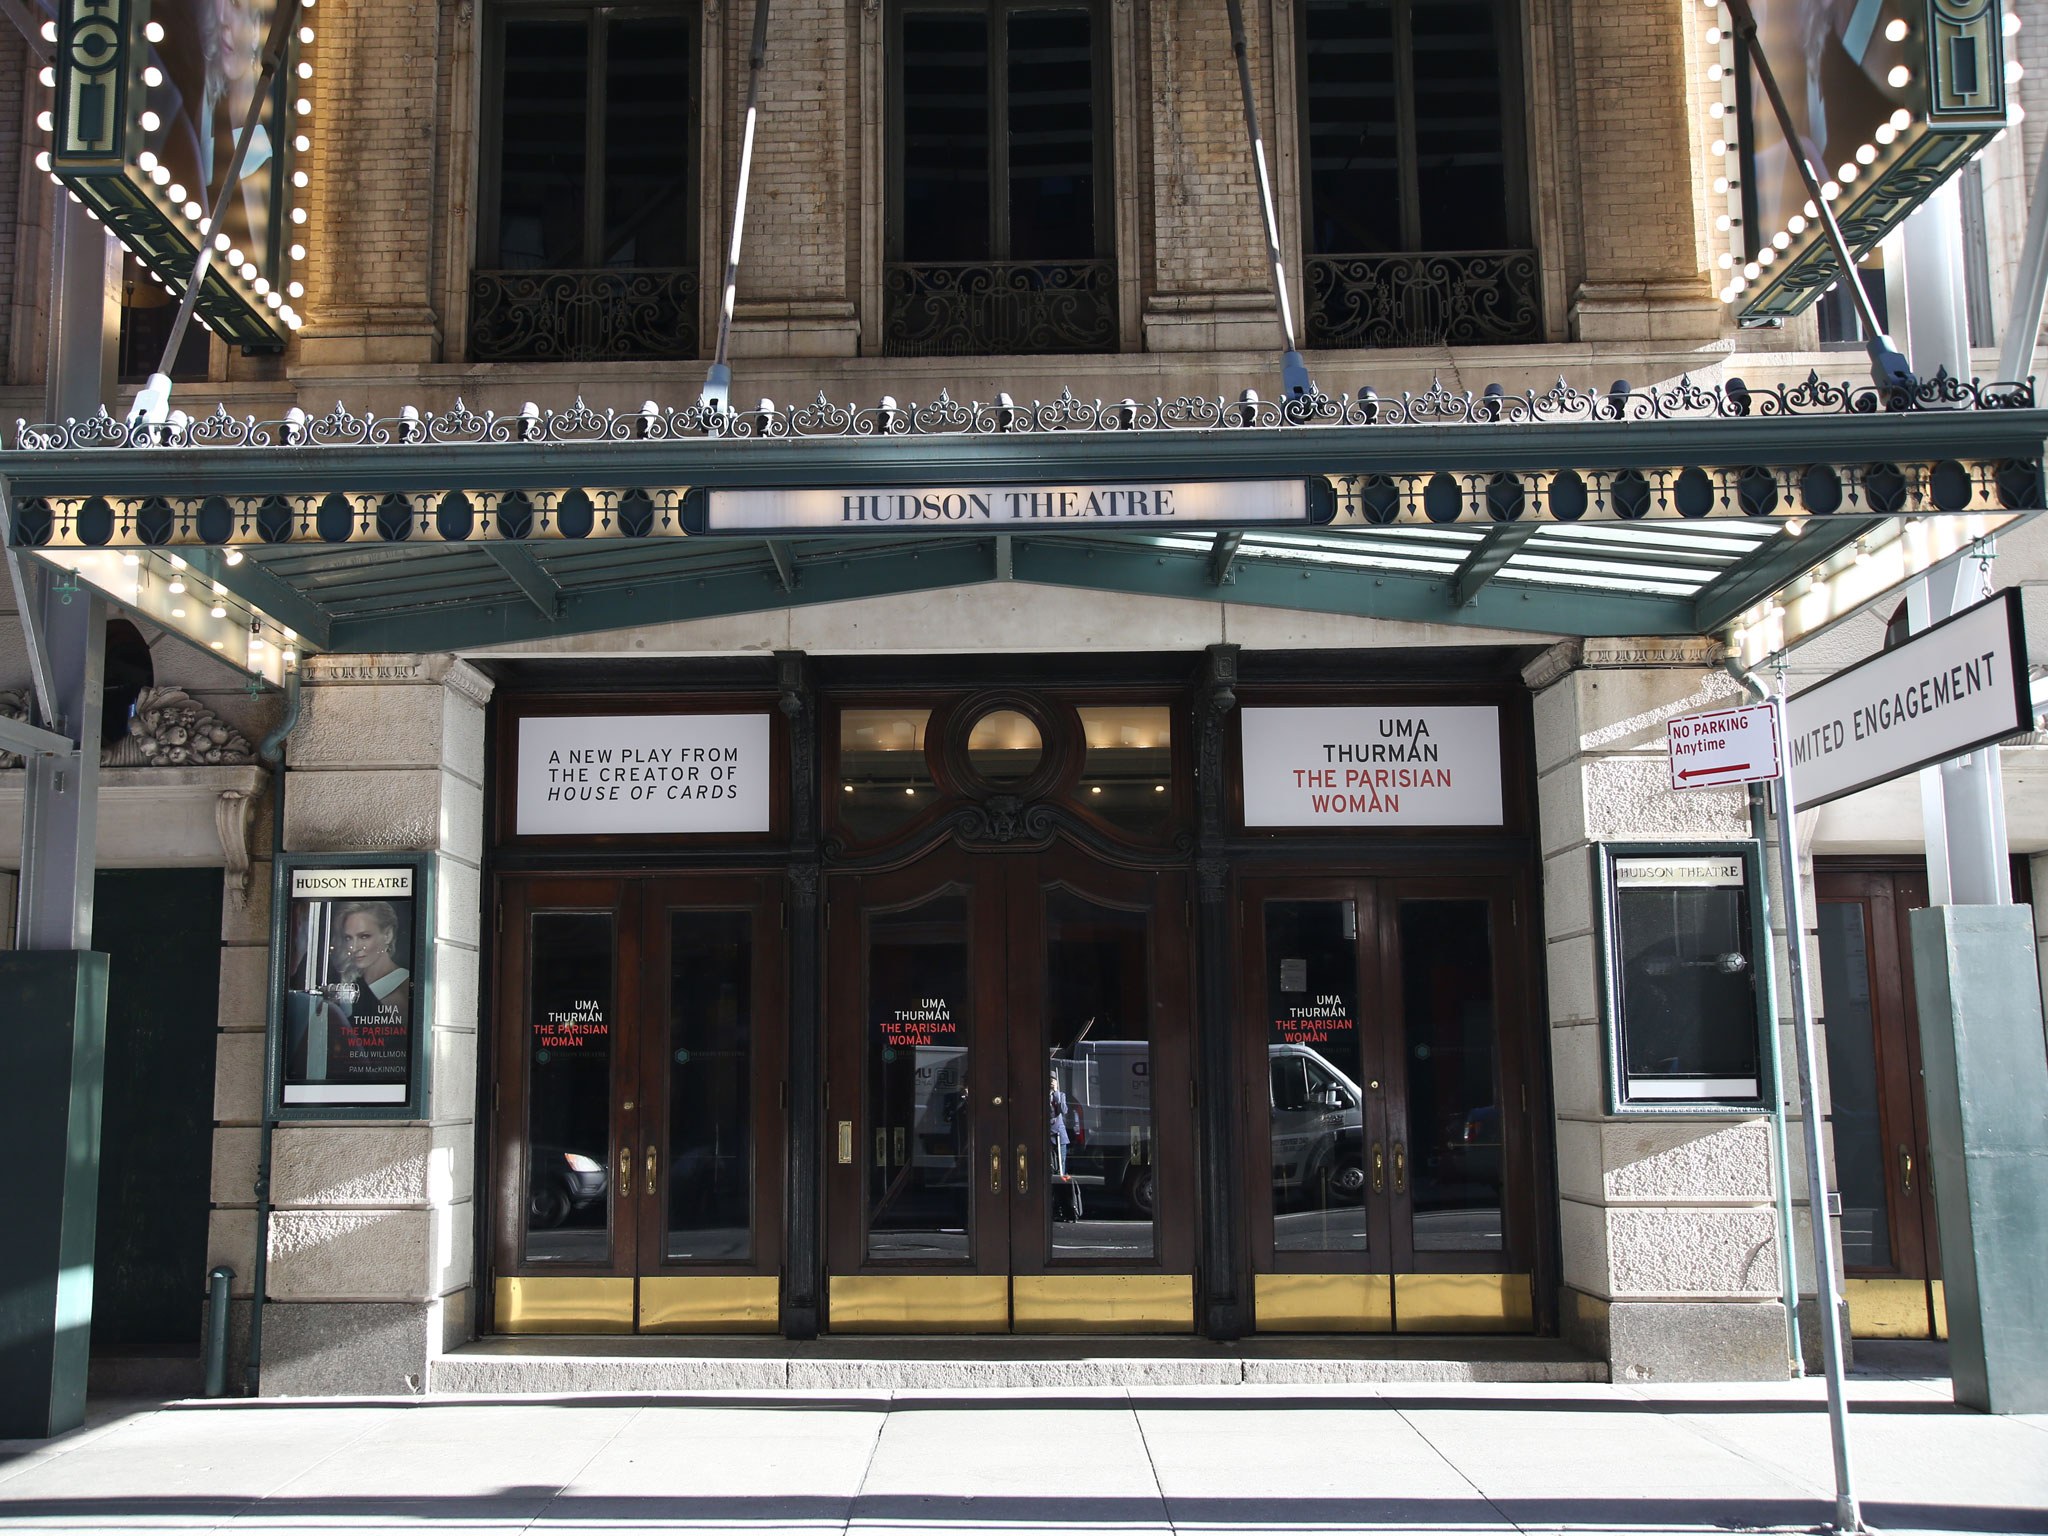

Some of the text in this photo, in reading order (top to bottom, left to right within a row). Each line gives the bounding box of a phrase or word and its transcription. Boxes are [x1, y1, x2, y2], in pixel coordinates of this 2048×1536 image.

[841, 489, 1177, 522] HUDSON THEATRE
[1788, 651, 1995, 768] IMITED ENGAGEMENT
[1379, 718, 1430, 737] UMA
[1673, 716, 1749, 739] NO PARKING
[1322, 743, 1438, 763] THURMAN
[1675, 739, 1726, 756] Anytime
[548, 747, 738, 764] A NEW PLAY FROM
[548, 766, 738, 783] THE CREATOR OF
[1293, 768, 1452, 788] THE PARISIAN
[548, 784, 738, 801] HOUSE OF CARDS
[1311, 794, 1400, 813] WOMAN
[1620, 865, 1740, 878] HUDSON THEATRE
[295, 876, 409, 889] HUDSON THEATRE
[574, 1000, 599, 1010] UMA
[921, 998, 946, 1009] UMA
[1316, 994, 1342, 1005] UMA
[377, 1004, 399, 1014] UMA
[1289, 1007, 1346, 1017] THURMAN
[353, 1015, 402, 1025] THURMAN
[548, 1012, 603, 1022] THURMAN
[894, 1010, 950, 1021] THURMAN
[533, 1024, 609, 1034] THE PARISIAN
[880, 1023, 956, 1033] THE PARISIAN
[1275, 1019, 1353, 1030] THE PARISIAN
[340, 1026, 408, 1036] THE PARISIAN
[347, 1037, 385, 1047] WOMAN
[541, 1036, 584, 1047] WOMAN
[888, 1035, 931, 1045] WOMAN
[1284, 1032, 1328, 1042] WOMAN
[349, 1050, 407, 1058] BEAU WILLIMON
